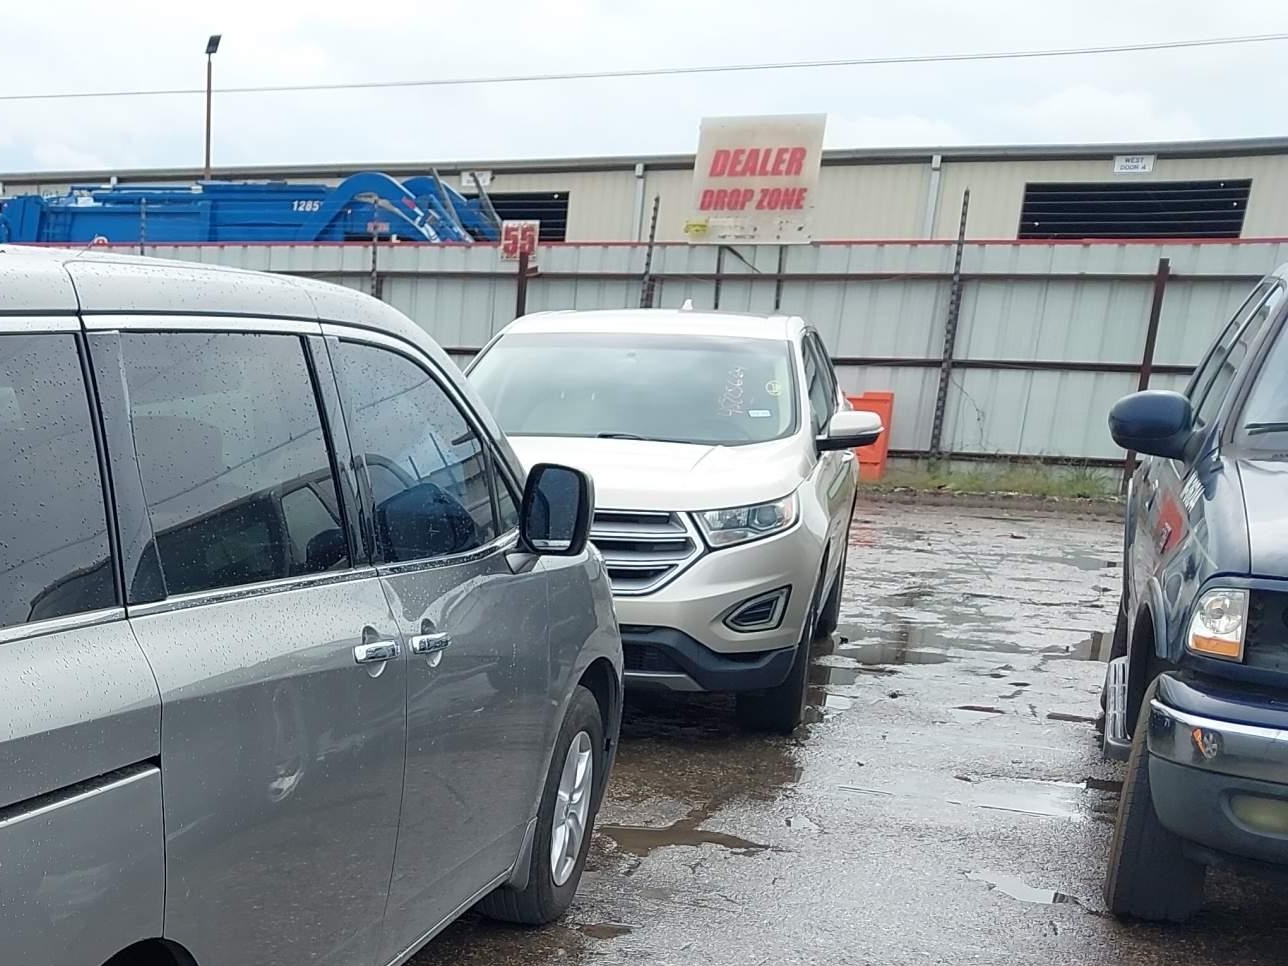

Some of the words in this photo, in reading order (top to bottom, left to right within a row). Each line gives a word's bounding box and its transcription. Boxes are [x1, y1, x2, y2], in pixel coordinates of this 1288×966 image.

[709, 147, 807, 176] DEALER
[700, 189, 755, 211] DROP
[755, 187, 808, 210] ZONE
[503, 224, 537, 257] 55
